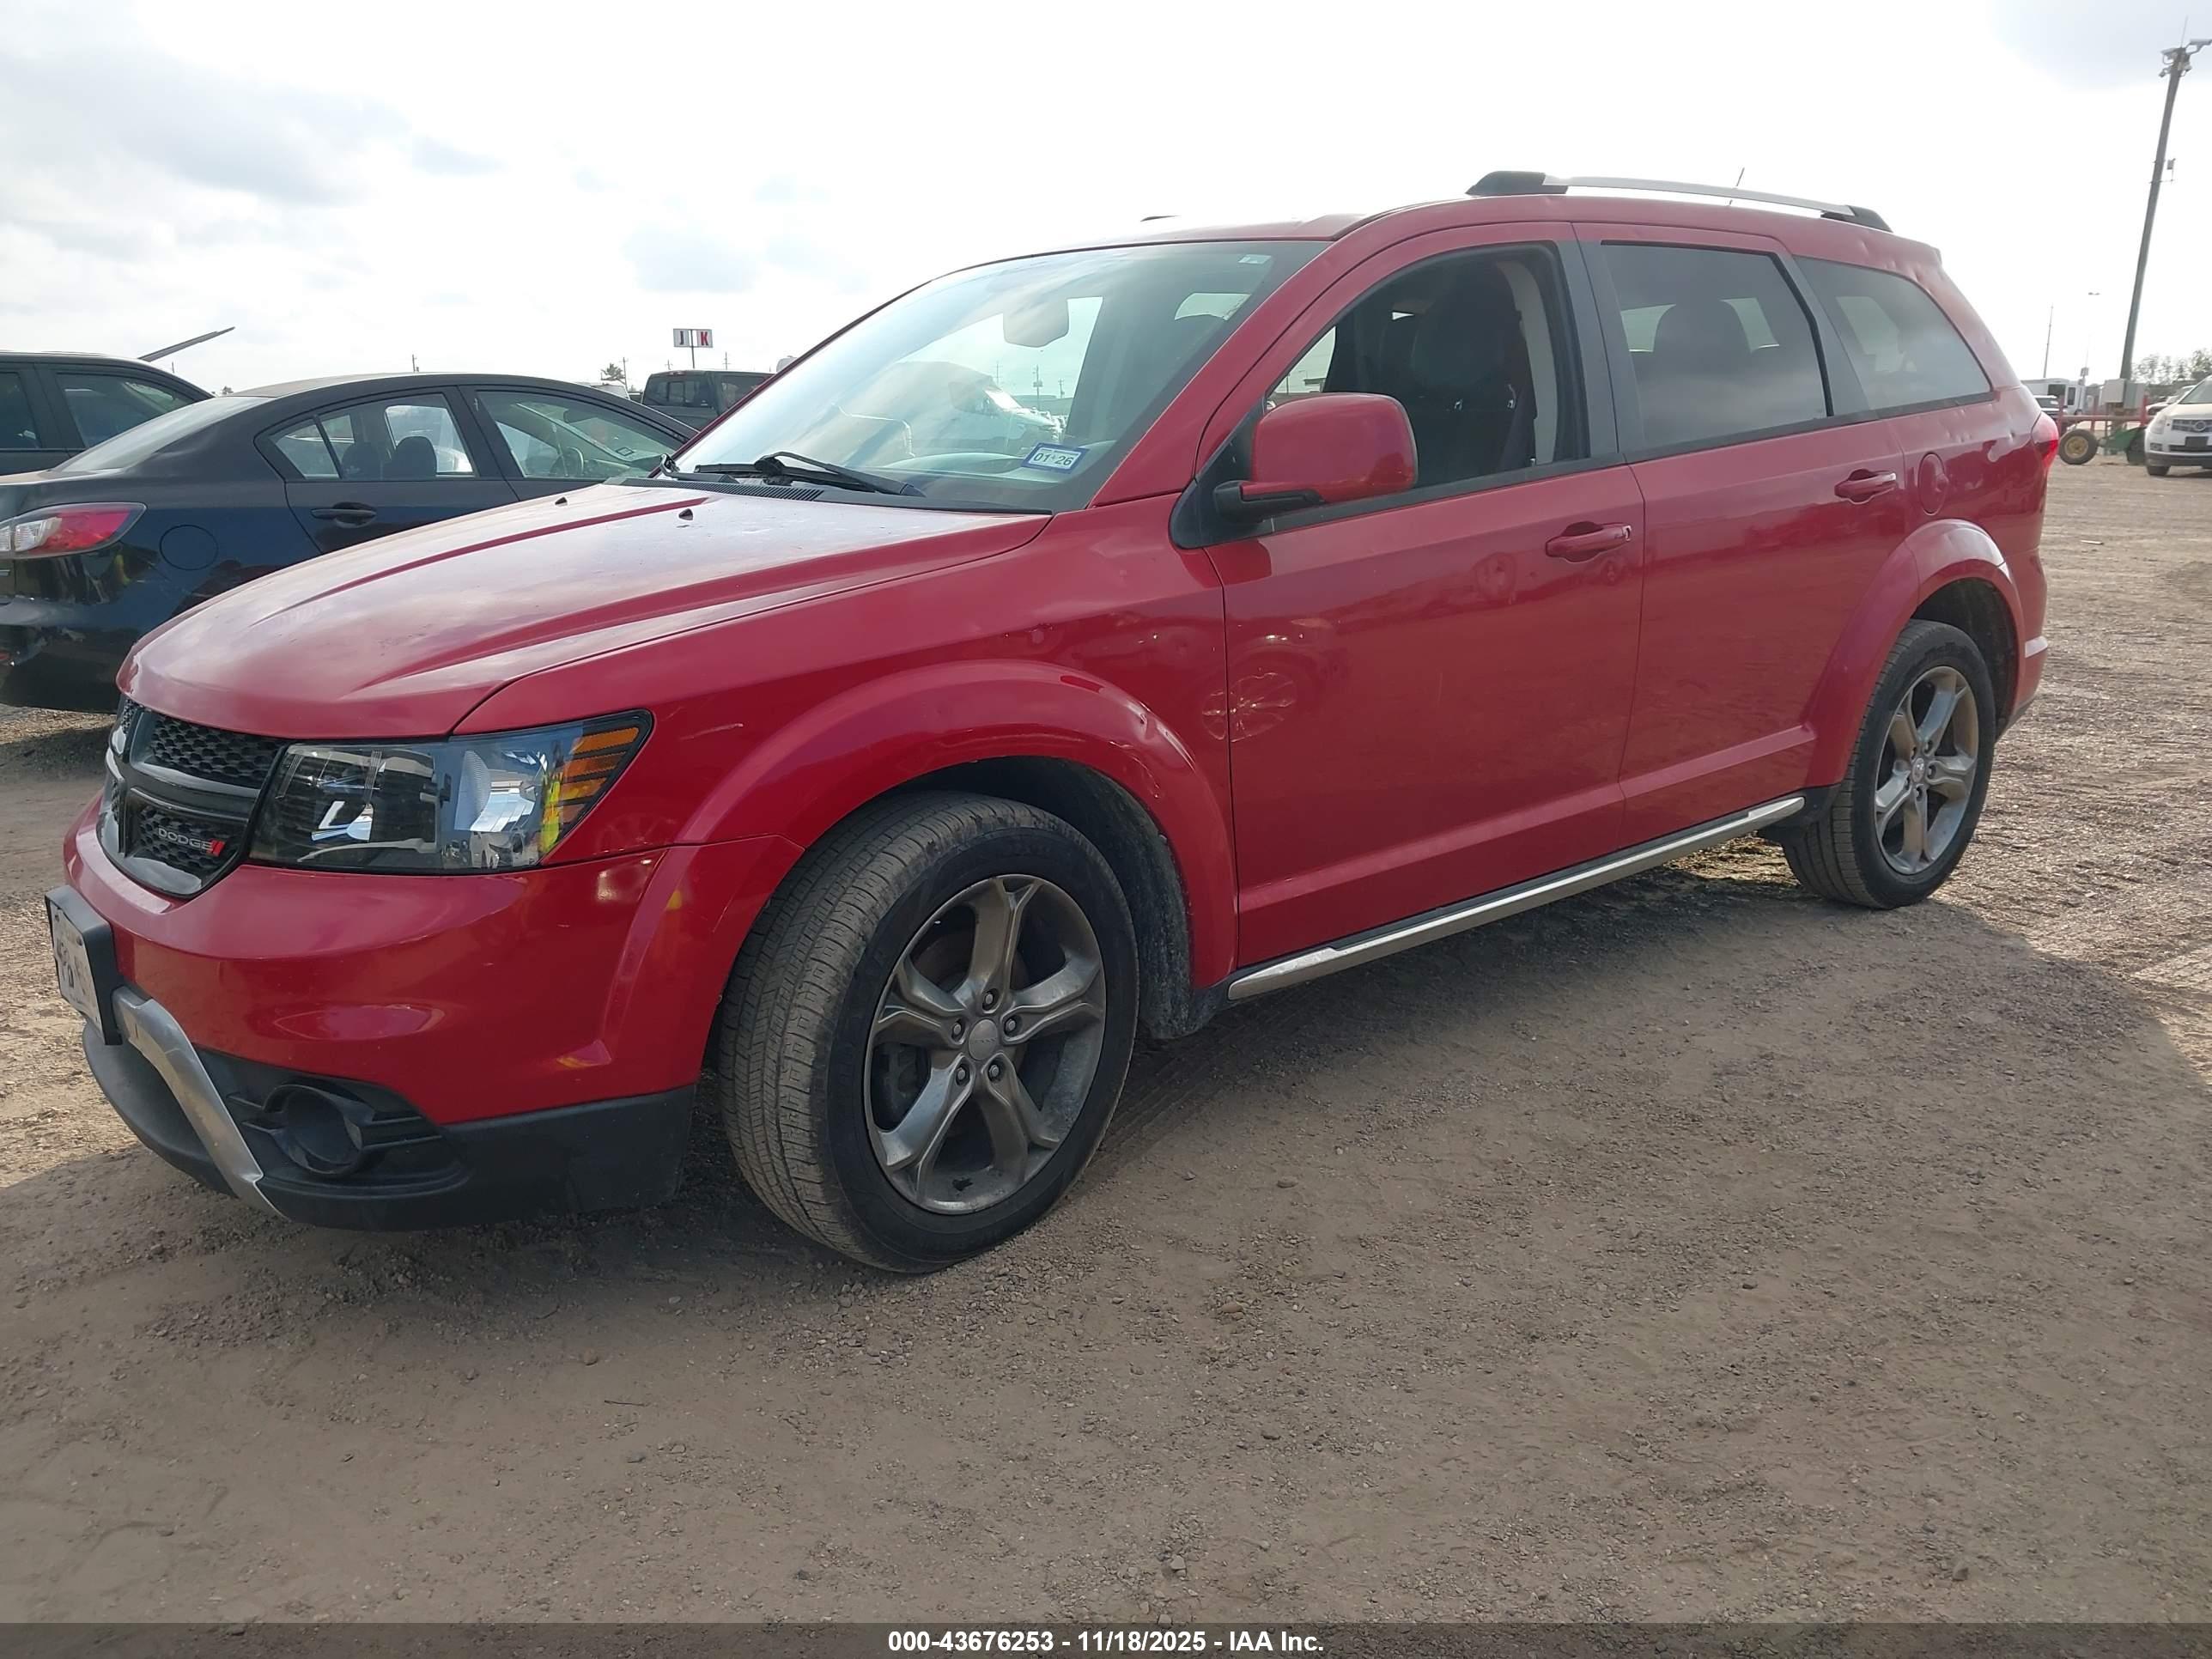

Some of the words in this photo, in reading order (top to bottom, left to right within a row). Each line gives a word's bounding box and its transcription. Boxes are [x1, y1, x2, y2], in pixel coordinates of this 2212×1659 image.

[701, 331, 709, 346] K
[1033, 453, 1052, 462] 01
[1054, 455, 1074, 465] 26
[158, 828, 214, 852] DODGE
